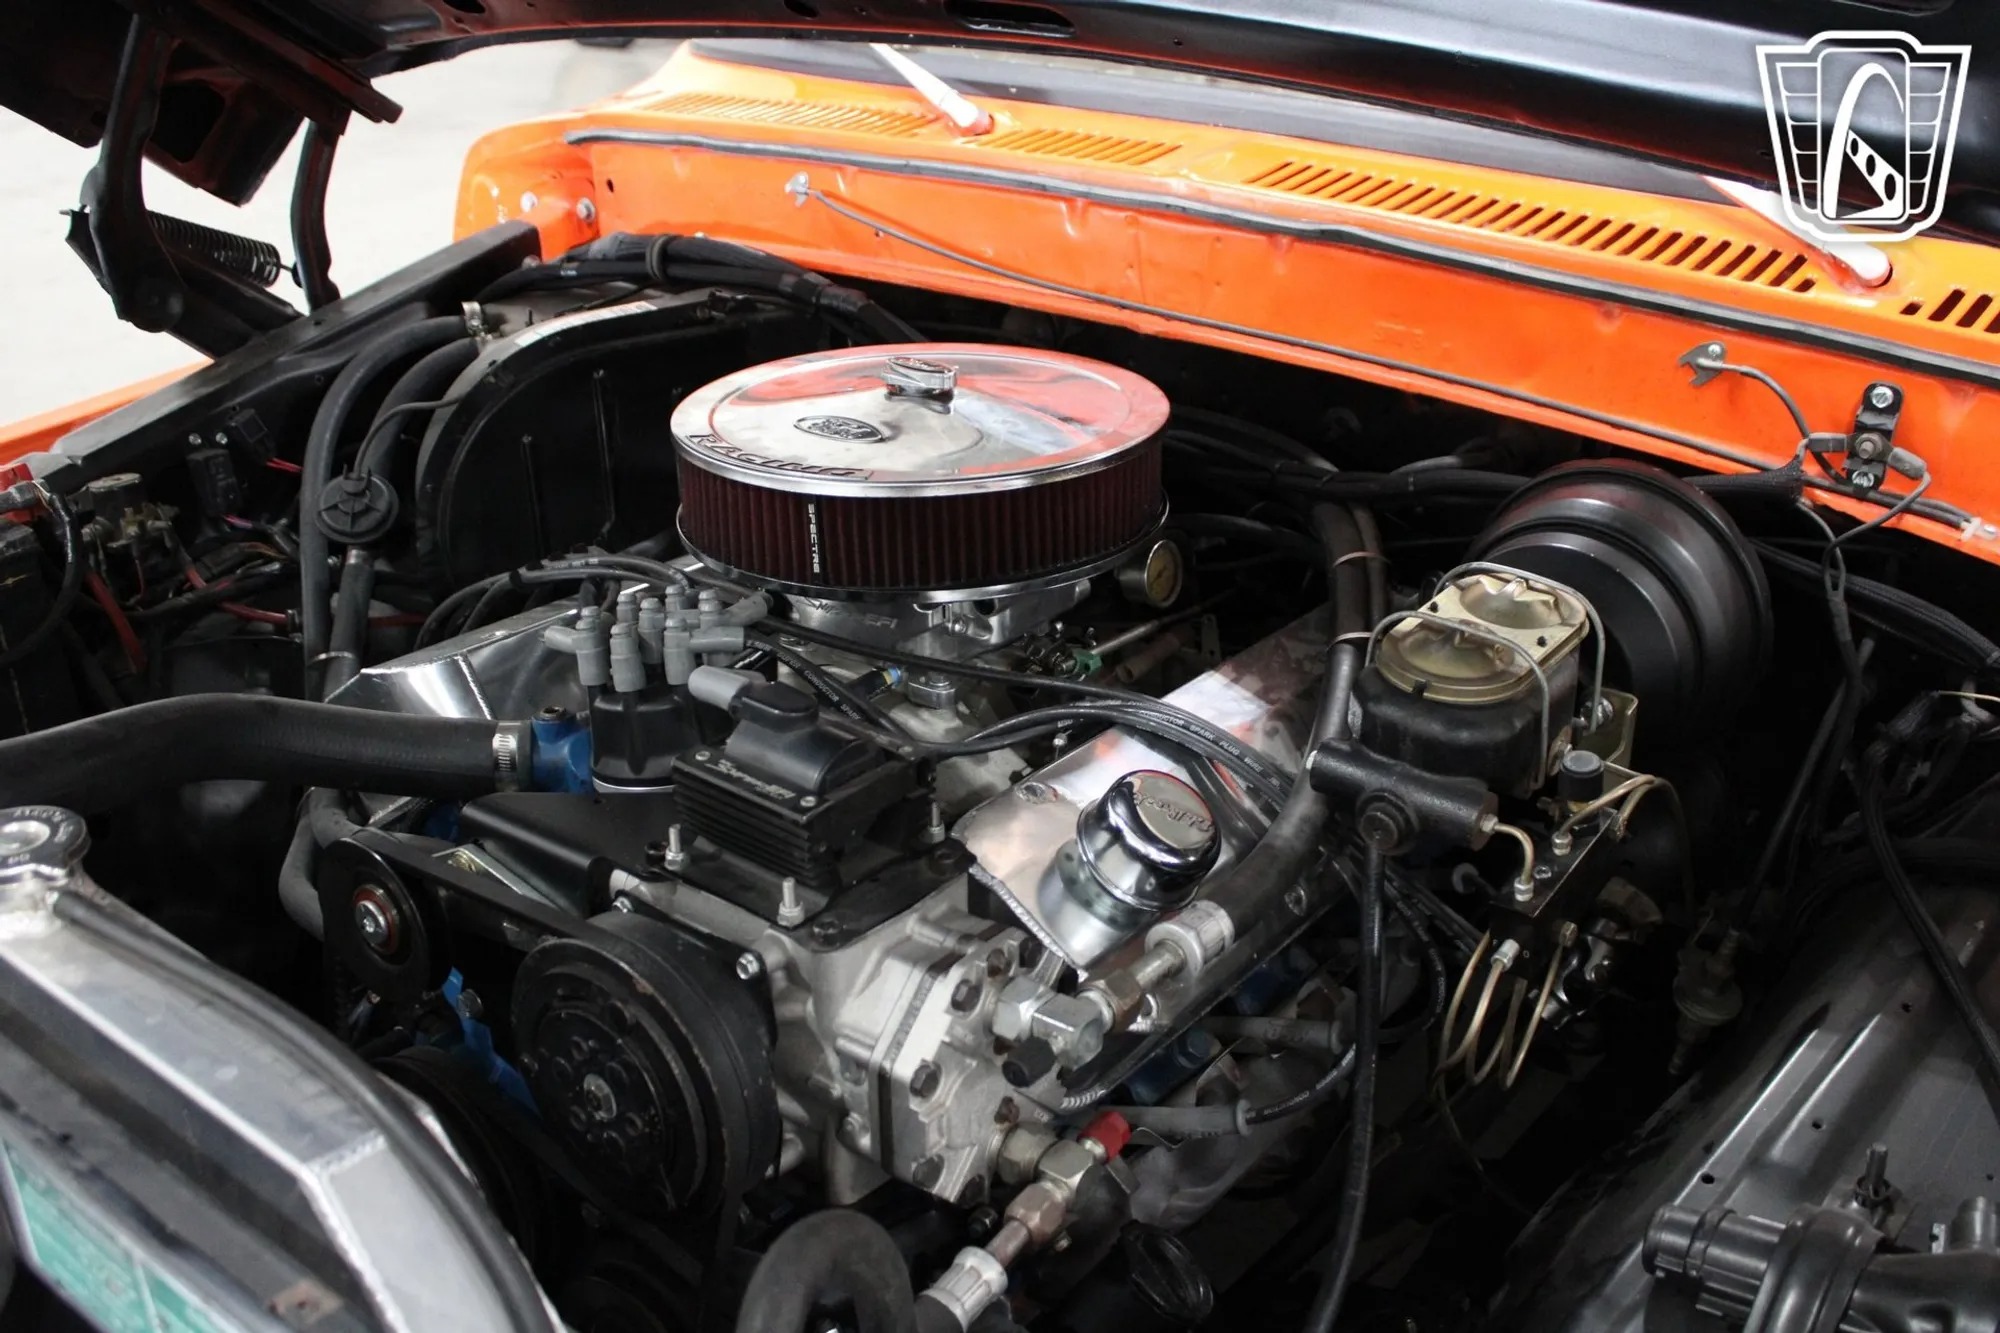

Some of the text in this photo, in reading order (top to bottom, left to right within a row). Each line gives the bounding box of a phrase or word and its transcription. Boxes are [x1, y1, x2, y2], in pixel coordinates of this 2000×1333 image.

[686, 433, 871, 480] RACING
[807, 503, 820, 573] SPECTRE
[804, 670, 840, 702] CONDUCTOR
[840, 703, 861, 720] SPARK
[1189, 724, 1216, 742] SPARK
[1219, 740, 1241, 756] PLUG
